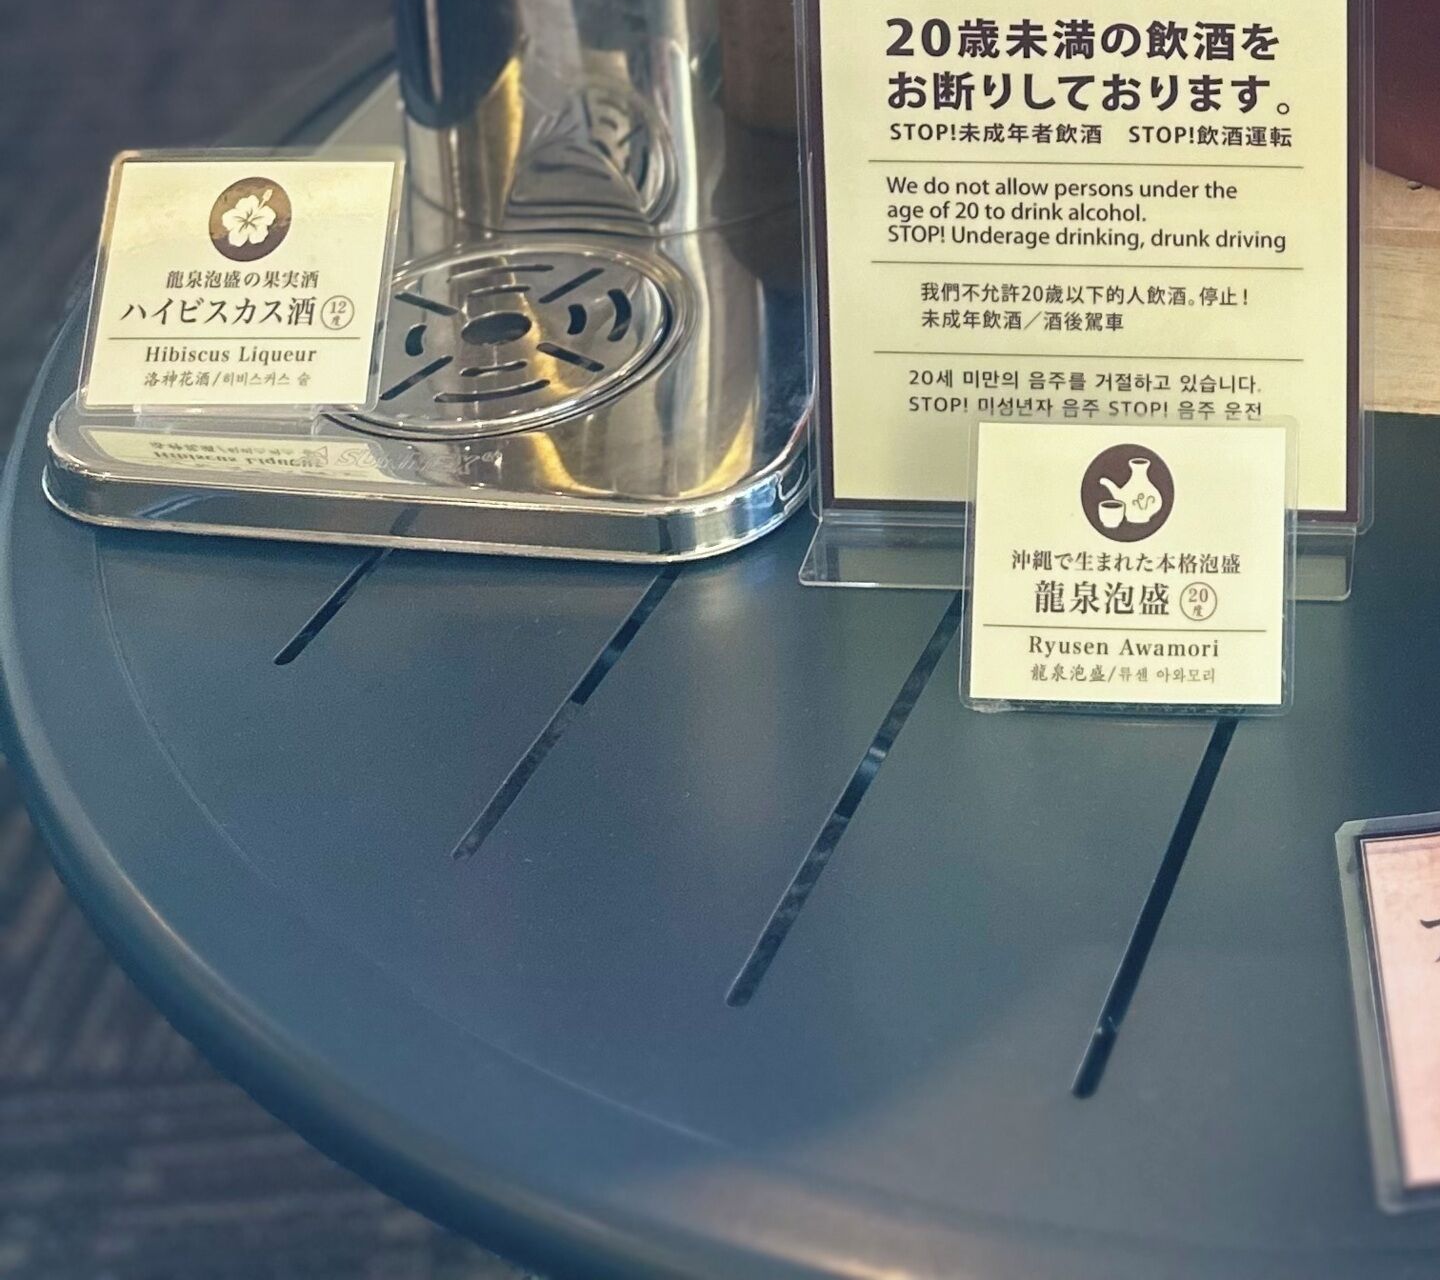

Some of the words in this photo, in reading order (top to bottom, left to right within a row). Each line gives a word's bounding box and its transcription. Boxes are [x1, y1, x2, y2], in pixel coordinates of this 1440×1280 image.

[886, 17, 1280, 61] 20歳未満の飲酒を
[887, 70, 1291, 115] お断りしております。
[887, 176, 919, 195] We
[924, 177, 950, 196] do
[955, 179, 989, 196] not
[995, 177, 1049, 197] allow
[1054, 181, 1134, 201] persons
[1139, 179, 1199, 199] under
[1204, 180, 1238, 200] the
[887, 204, 924, 225] age
[929, 201, 952, 220] of
[955, 202, 980, 221] 20
[984, 204, 1005, 221] to
[1011, 201, 1063, 221] drink
[1068, 202, 1147, 223] alcohol.
[887, 225, 946, 244] STOP!
[952, 226, 1050, 250] Underage
[1055, 228, 1145, 252] drinking,
[1150, 228, 1210, 248] drunk
[1215, 229, 1287, 253] driving
[166, 269, 320, 290] 龍泉泡盛の果実酒
[119, 295, 317, 327] ハイビスカス酒
[329, 300, 346, 315] 12
[144, 346, 230, 363] Hibiscus
[238, 346, 317, 366] Liqueur
[908, 369, 953, 388] 20세
[962, 369, 1019, 390] 미만의
[1028, 370, 1087, 391] 음주를
[1095, 372, 1171, 393] 거절하고
[1180, 373, 1262, 395] 있습니다.
[908, 396, 969, 413] STOP!
[978, 396, 1053, 417] 미성년자
[1061, 398, 1099, 419] 음주
[1107, 401, 1169, 419] STOP!
[1177, 400, 1216, 421] 음주
[1224, 401, 1262, 422] 운전
[1011, 549, 1241, 575] 沖縄で生まれた本格泡盛
[1034, 579, 1170, 615] 龍泉泡盛
[1187, 587, 1209, 605] 20
[1028, 635, 1109, 658] Ryusen
[1119, 638, 1219, 658] Awamori
[1156, 666, 1216, 684] 아와모리
